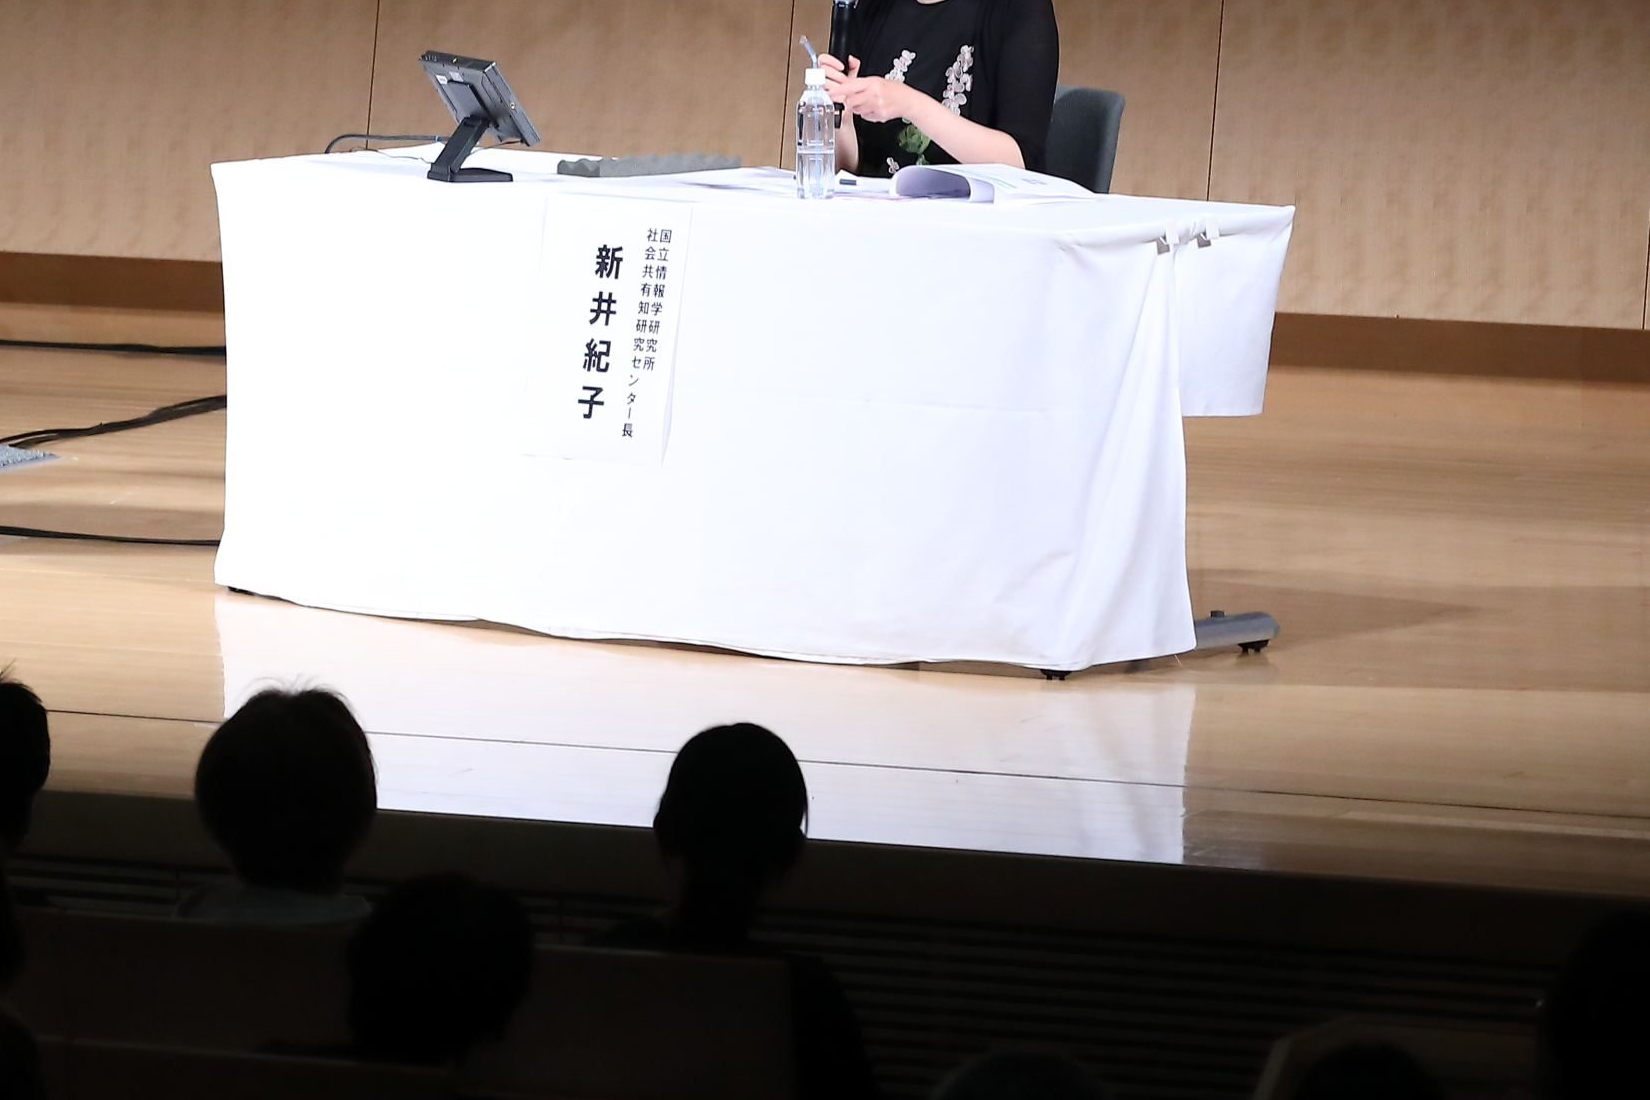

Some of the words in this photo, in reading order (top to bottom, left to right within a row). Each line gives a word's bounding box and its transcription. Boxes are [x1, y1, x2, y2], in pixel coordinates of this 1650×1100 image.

[577, 244, 623, 419] 新井紀子
[621, 227, 658, 438] 社会共有知研究センター長
[642, 229, 672, 371] 国立情報学研究所
